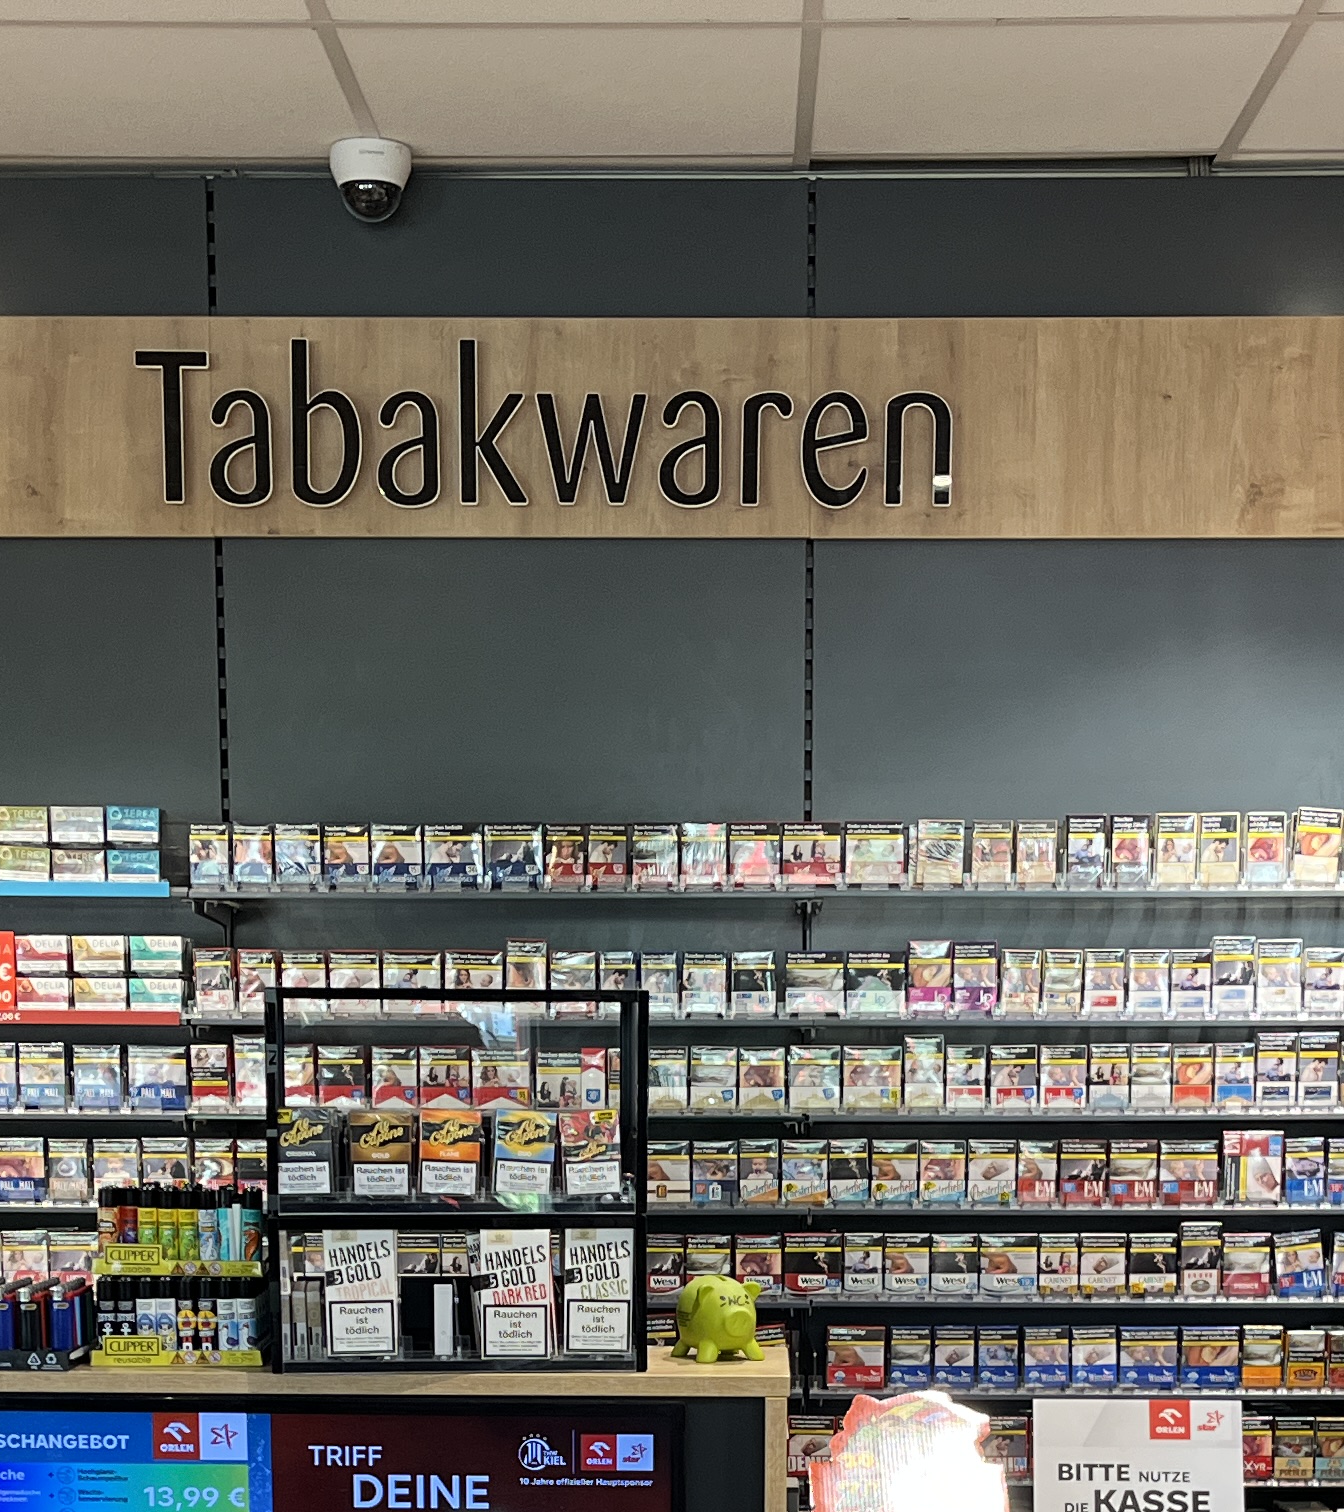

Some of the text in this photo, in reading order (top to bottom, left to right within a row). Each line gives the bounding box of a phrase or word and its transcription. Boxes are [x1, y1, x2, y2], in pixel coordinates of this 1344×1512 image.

[134, 338, 952, 509] Tabakwaren
[110, 1249, 156, 1261] CLIPPER
[328, 1240, 391, 1267] HANDELS
[485, 1245, 547, 1271] HANDELS
[570, 1240, 631, 1268] HANDELS
[345, 1261, 382, 1284] GOLD
[501, 1265, 537, 1288] GOLD
[585, 1262, 620, 1284] GOLD
[109, 1341, 156, 1353] CLIPPER
[1156, 1426, 1185, 1434] ORLEN
[1197, 1424, 1216, 1432] star
[159, 1443, 194, 1453] ORLEN
[308, 1445, 383, 1467] TRIFF
[544, 1456, 566, 1465] KIEL
[556, 1478, 593, 1486] offizieller
[596, 1478, 653, 1487] Hauptsponsor
[1058, 1463, 1190, 1483] BITTE NUTZE
[143, 1486, 246, 1511] 13,99 €
[352, 1474, 490, 1510] DEINE
